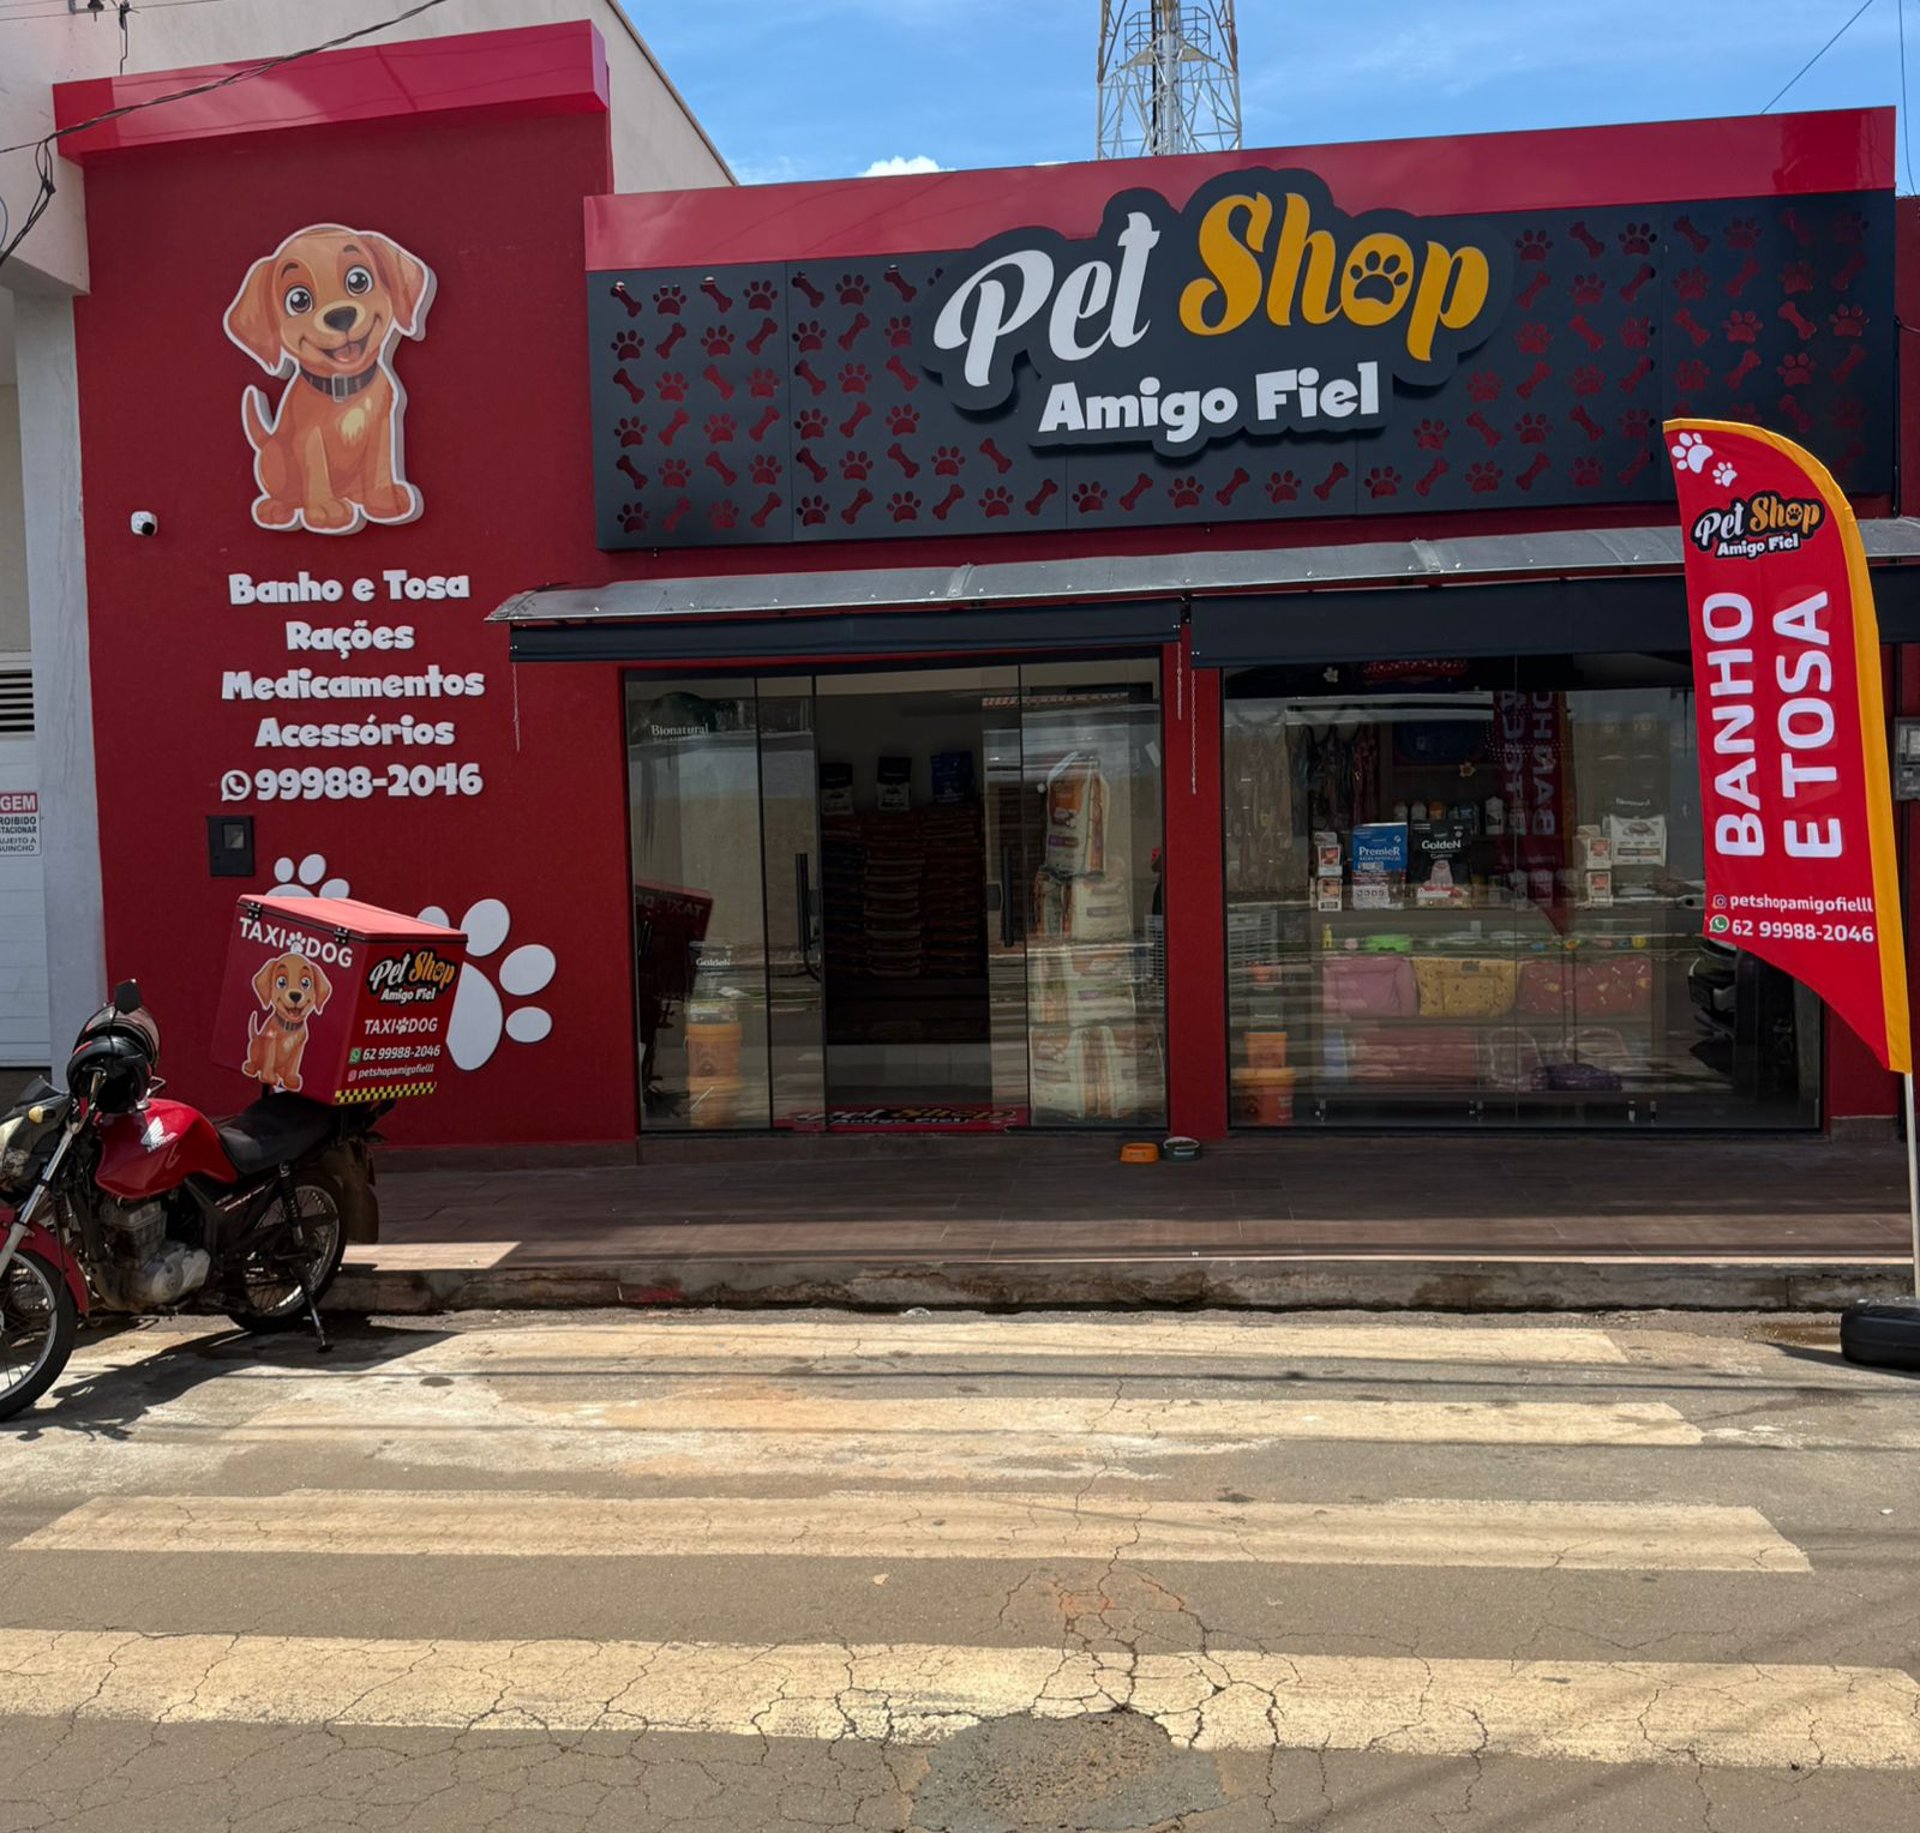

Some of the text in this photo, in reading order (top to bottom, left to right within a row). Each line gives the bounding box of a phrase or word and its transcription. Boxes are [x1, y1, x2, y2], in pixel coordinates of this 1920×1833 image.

[933, 191, 1489, 387] Pet Shop
[1038, 360, 1379, 443] Amigo Fiel
[1695, 495, 1820, 546] Pet Shop
[1717, 533, 1799, 558] Amigo Fiel
[228, 569, 470, 605] Banho e Tosa
[285, 619, 415, 660] Rações
[221, 664, 485, 700] Medicamentos
[254, 713, 455, 747] Acessórios
[1702, 592, 1765, 857] BANHO
[1772, 590, 1843, 858] E TOSA
[254, 762, 484, 801] 99988-2046
[1730, 894, 1873, 914] petshopamigofielll
[1732, 920, 1874, 943] 62 99988-2046
[369, 951, 456, 991] Pet Shop
[381, 987, 437, 1004] Amigo Fiel
[362, 1045, 440, 1060] 62 99988-2046
